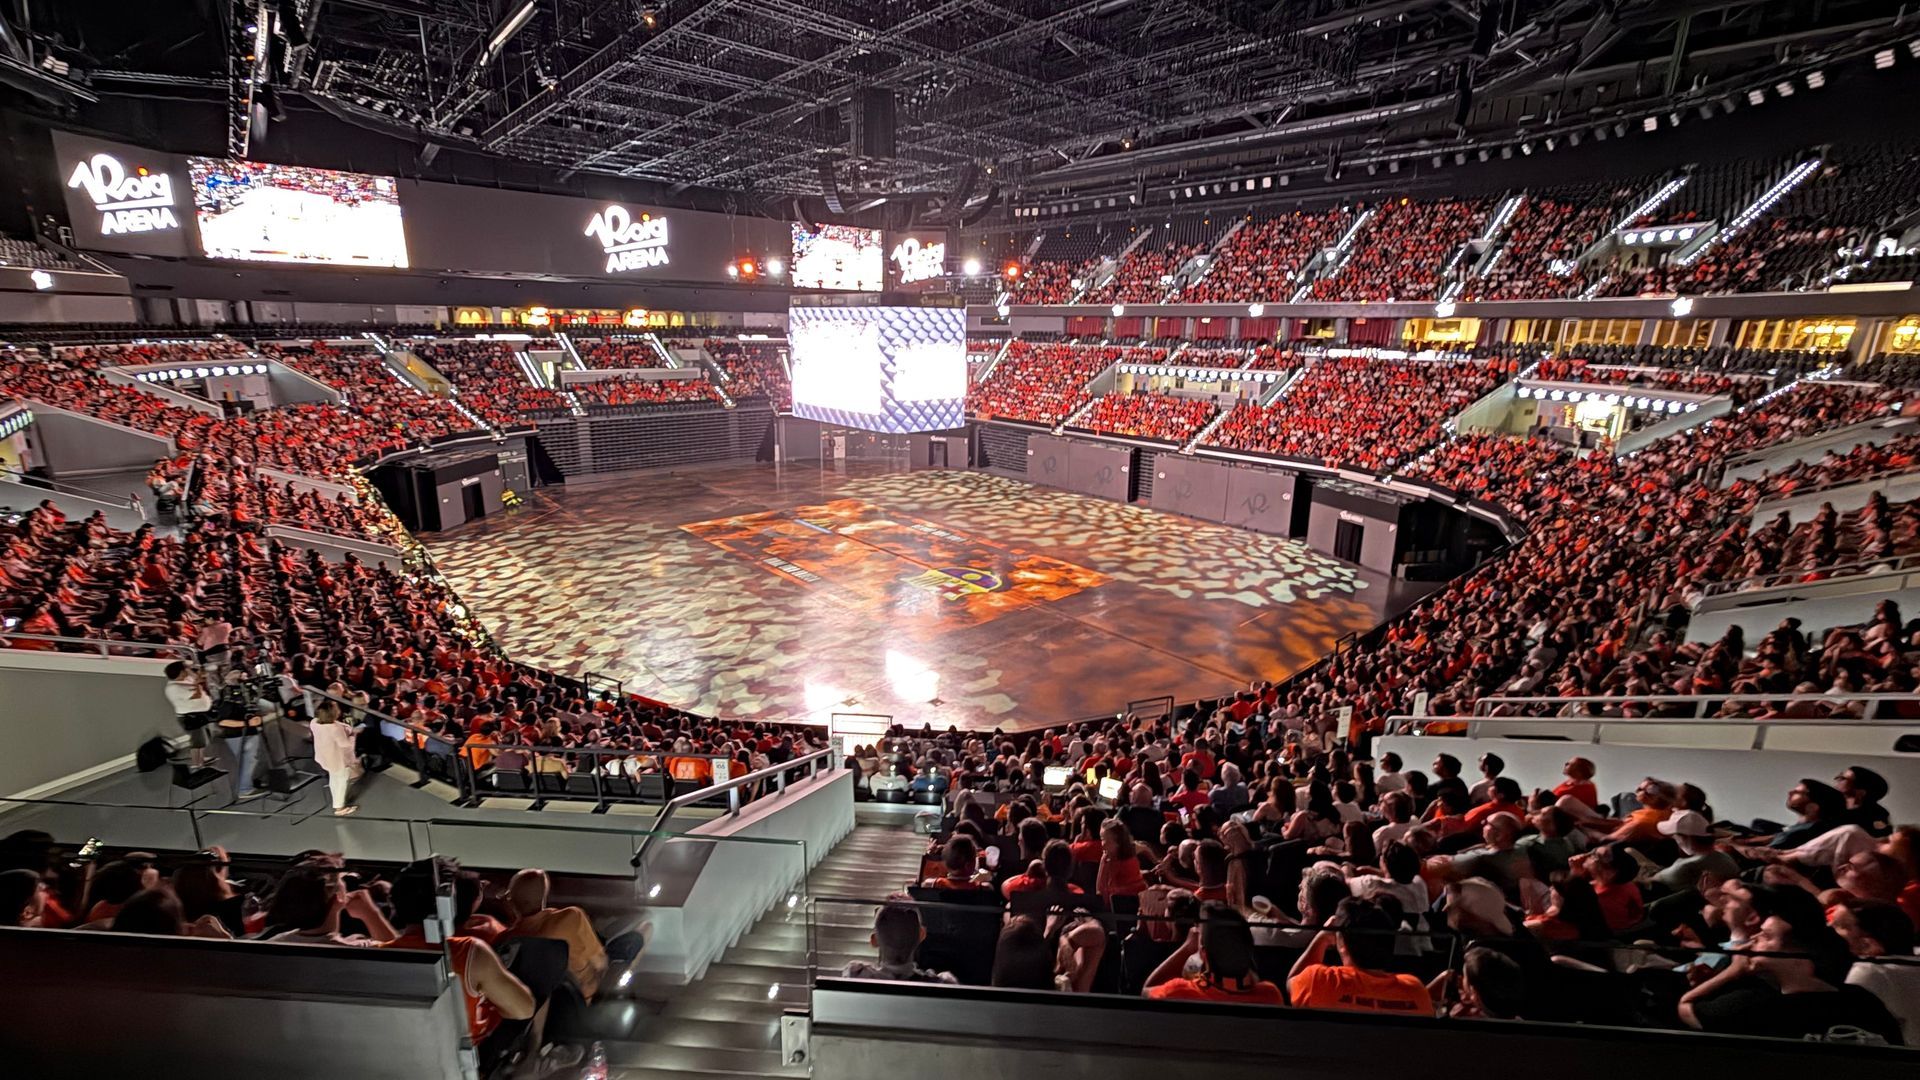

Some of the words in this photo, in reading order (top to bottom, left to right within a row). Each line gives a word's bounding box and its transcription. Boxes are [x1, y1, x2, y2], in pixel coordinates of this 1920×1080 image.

[67, 153, 174, 210] Roig
[101, 207, 178, 234] ARENA
[584, 205, 668, 253] Roig
[606, 246, 669, 273] ARENA
